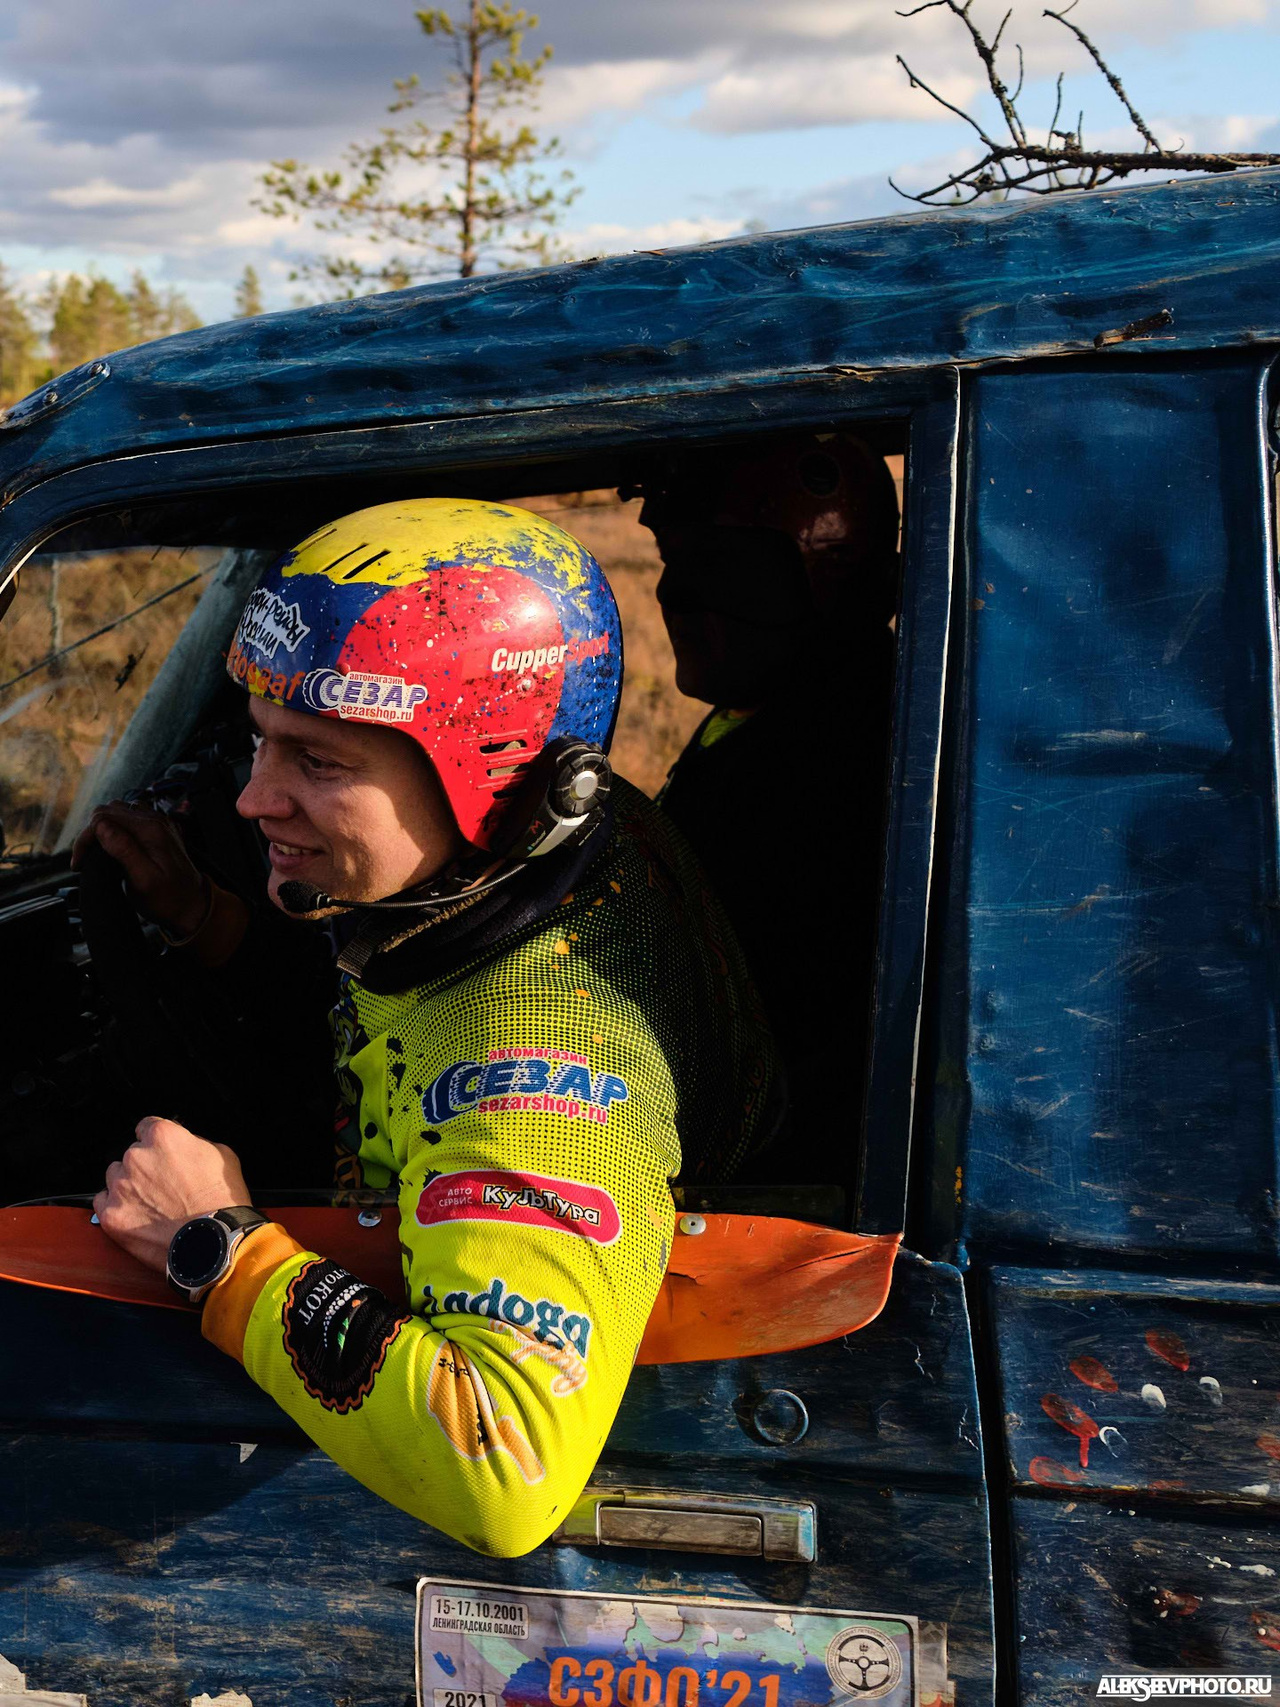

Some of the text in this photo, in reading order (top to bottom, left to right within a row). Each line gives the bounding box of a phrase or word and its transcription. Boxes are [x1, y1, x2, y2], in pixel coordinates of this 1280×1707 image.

[349, 673, 403, 685] автомагазин
[323, 678, 427, 709] СЕЗАР
[340, 704, 412, 721] sezarshop.ru
[488, 1047, 588, 1066] автомагазин
[450, 1059, 629, 1108] СЕЗАР
[478, 1094, 608, 1125] sezarshop.ru
[438, 1196, 473, 1208] СЕРВИС
[447, 1187, 473, 1197] АВТО
[436, 1598, 524, 1622] 15-17.10.2001
[432, 1616, 526, 1637] ЛЕНИНГРАДСКАЯ ОБЛАСТЬ
